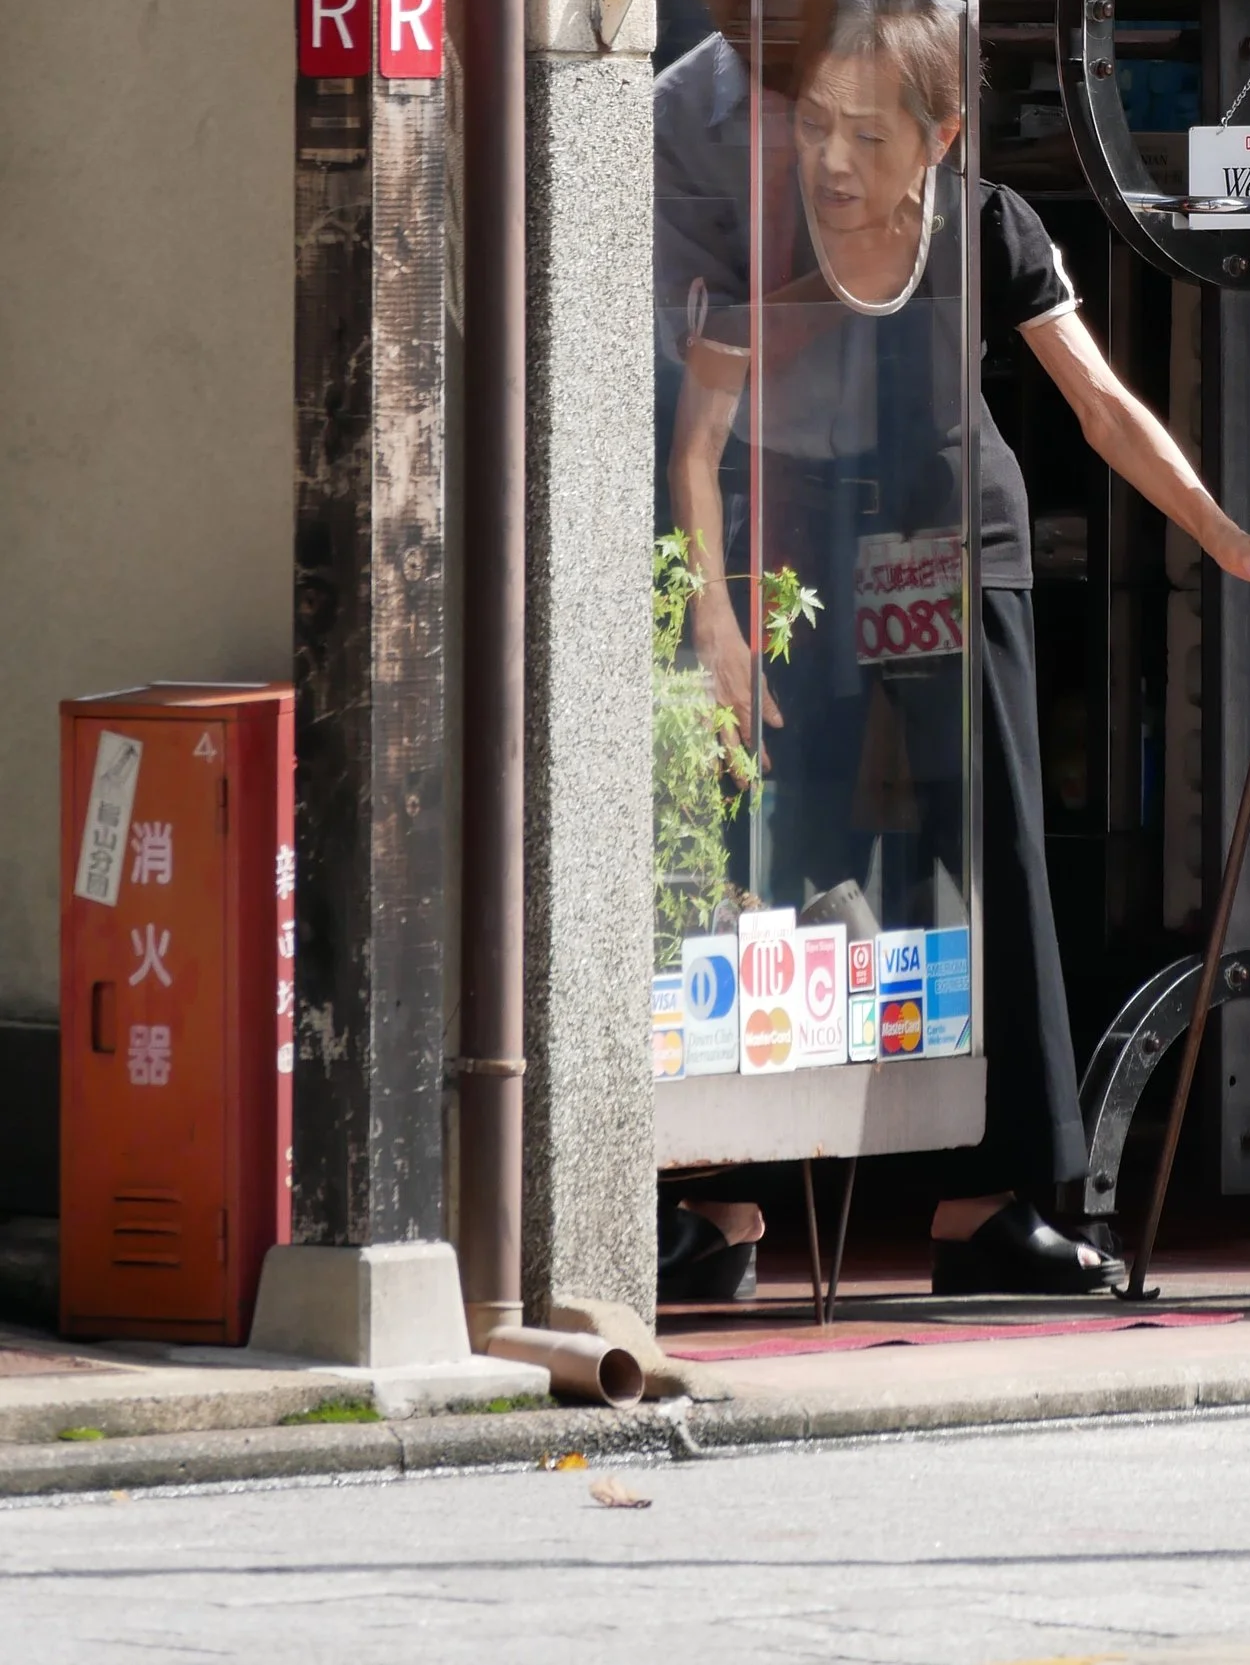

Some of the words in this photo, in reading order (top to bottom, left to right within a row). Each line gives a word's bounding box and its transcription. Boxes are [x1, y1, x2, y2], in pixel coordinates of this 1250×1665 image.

[193, 732, 217, 764] 4
[128, 821, 173, 1086] 消火器
[882, 945, 921, 973] VISA
[652, 992, 677, 1011] VISA
[881, 1020, 921, 1036] MasterCard
